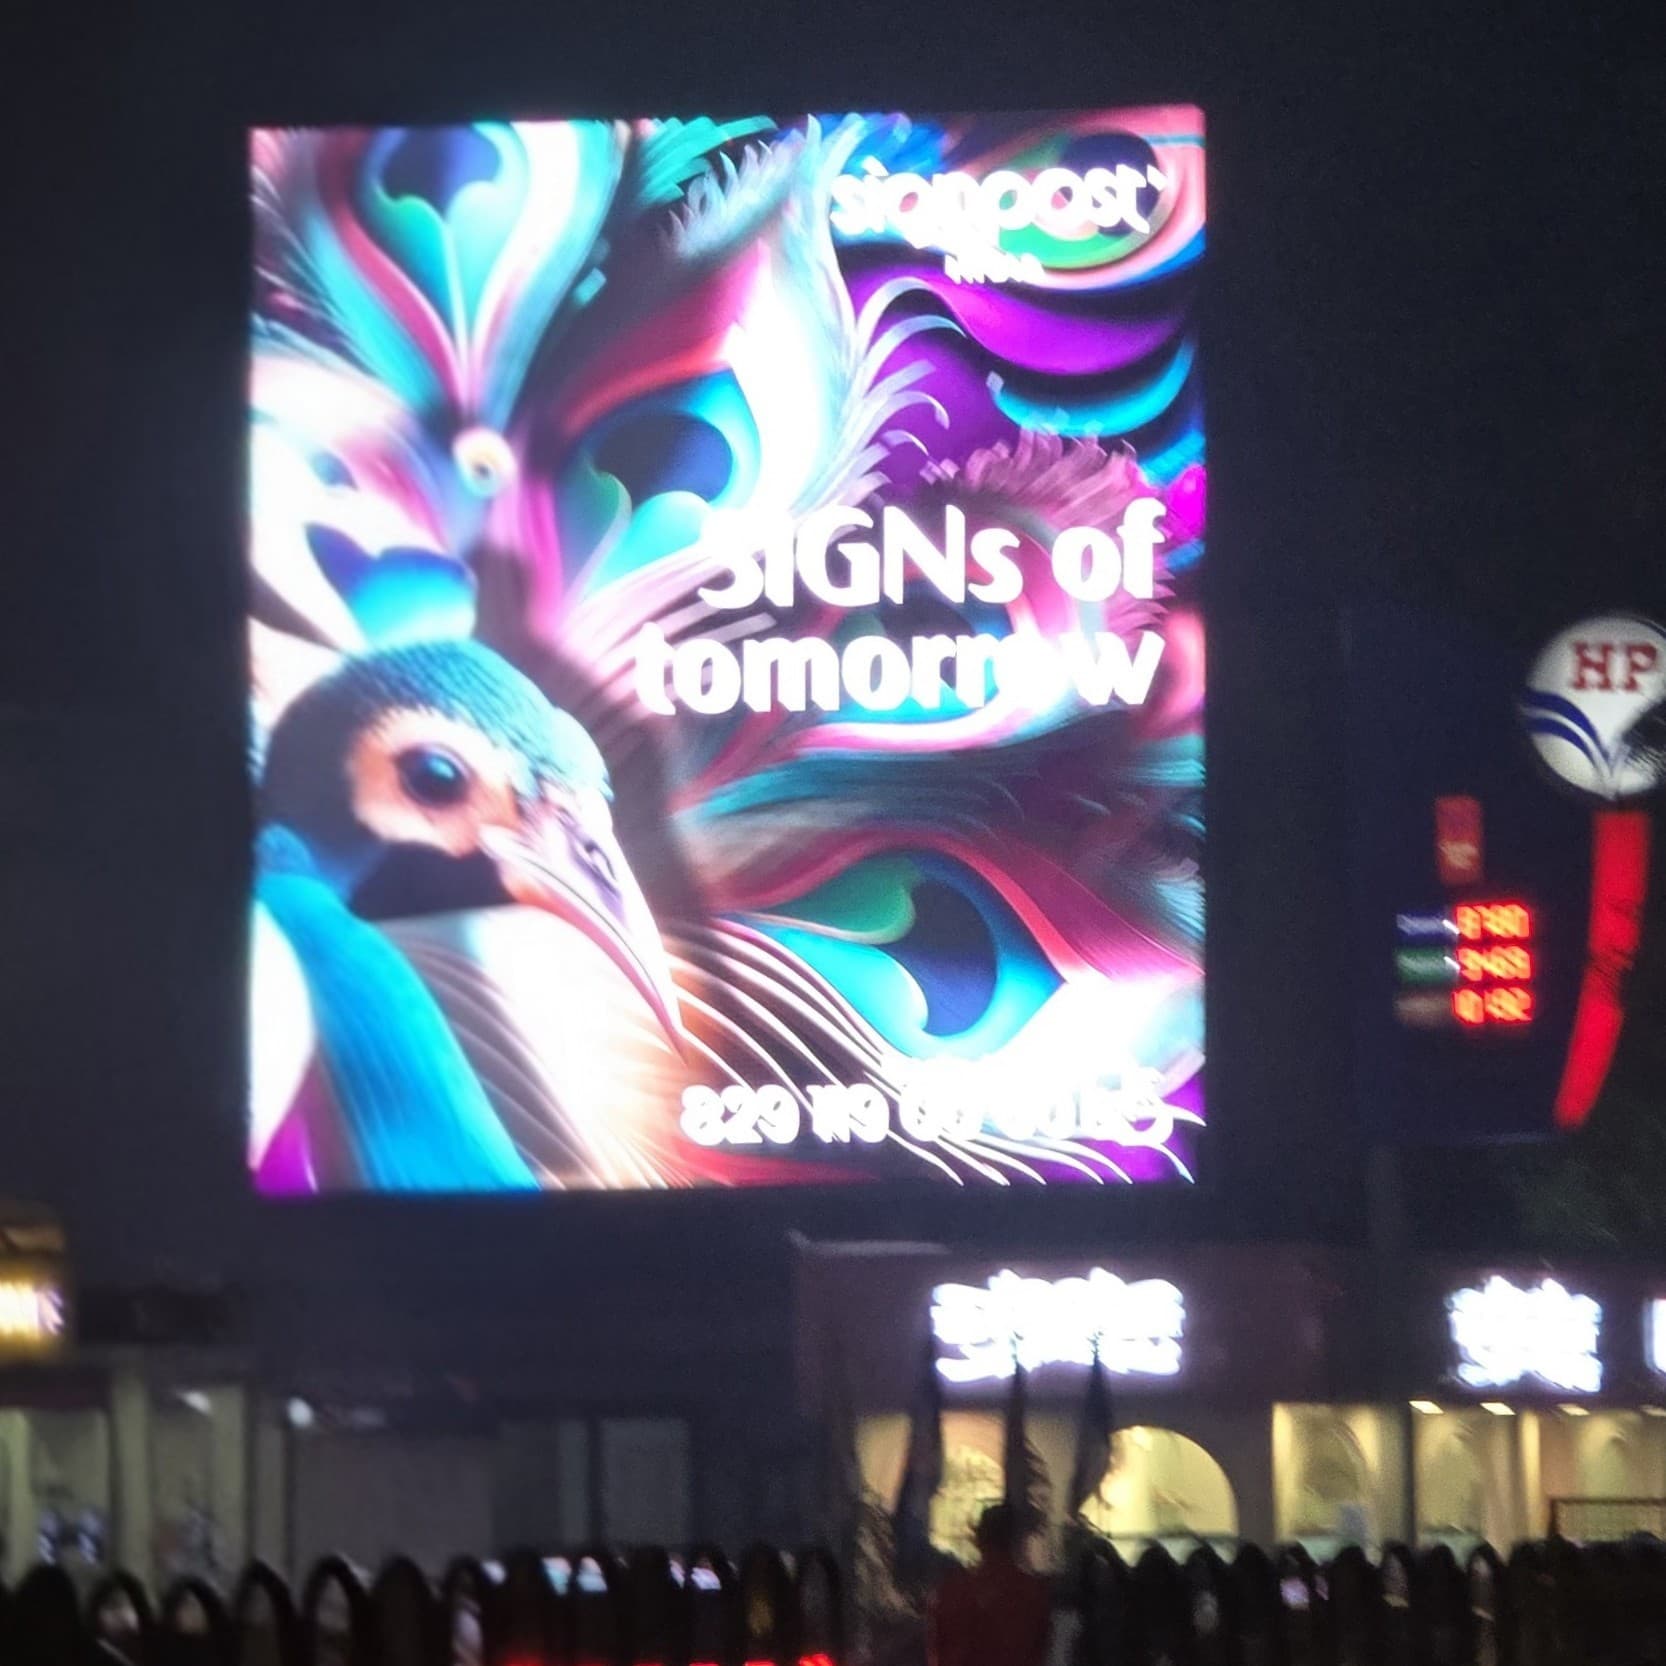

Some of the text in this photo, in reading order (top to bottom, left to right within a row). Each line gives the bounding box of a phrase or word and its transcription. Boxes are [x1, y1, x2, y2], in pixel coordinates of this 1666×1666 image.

[698, 497, 1167, 608] SIGNs of
[634, 621, 1165, 716] tomorrow
[1571, 640, 1658, 692] HP
[680, 1083, 800, 1146] 829
